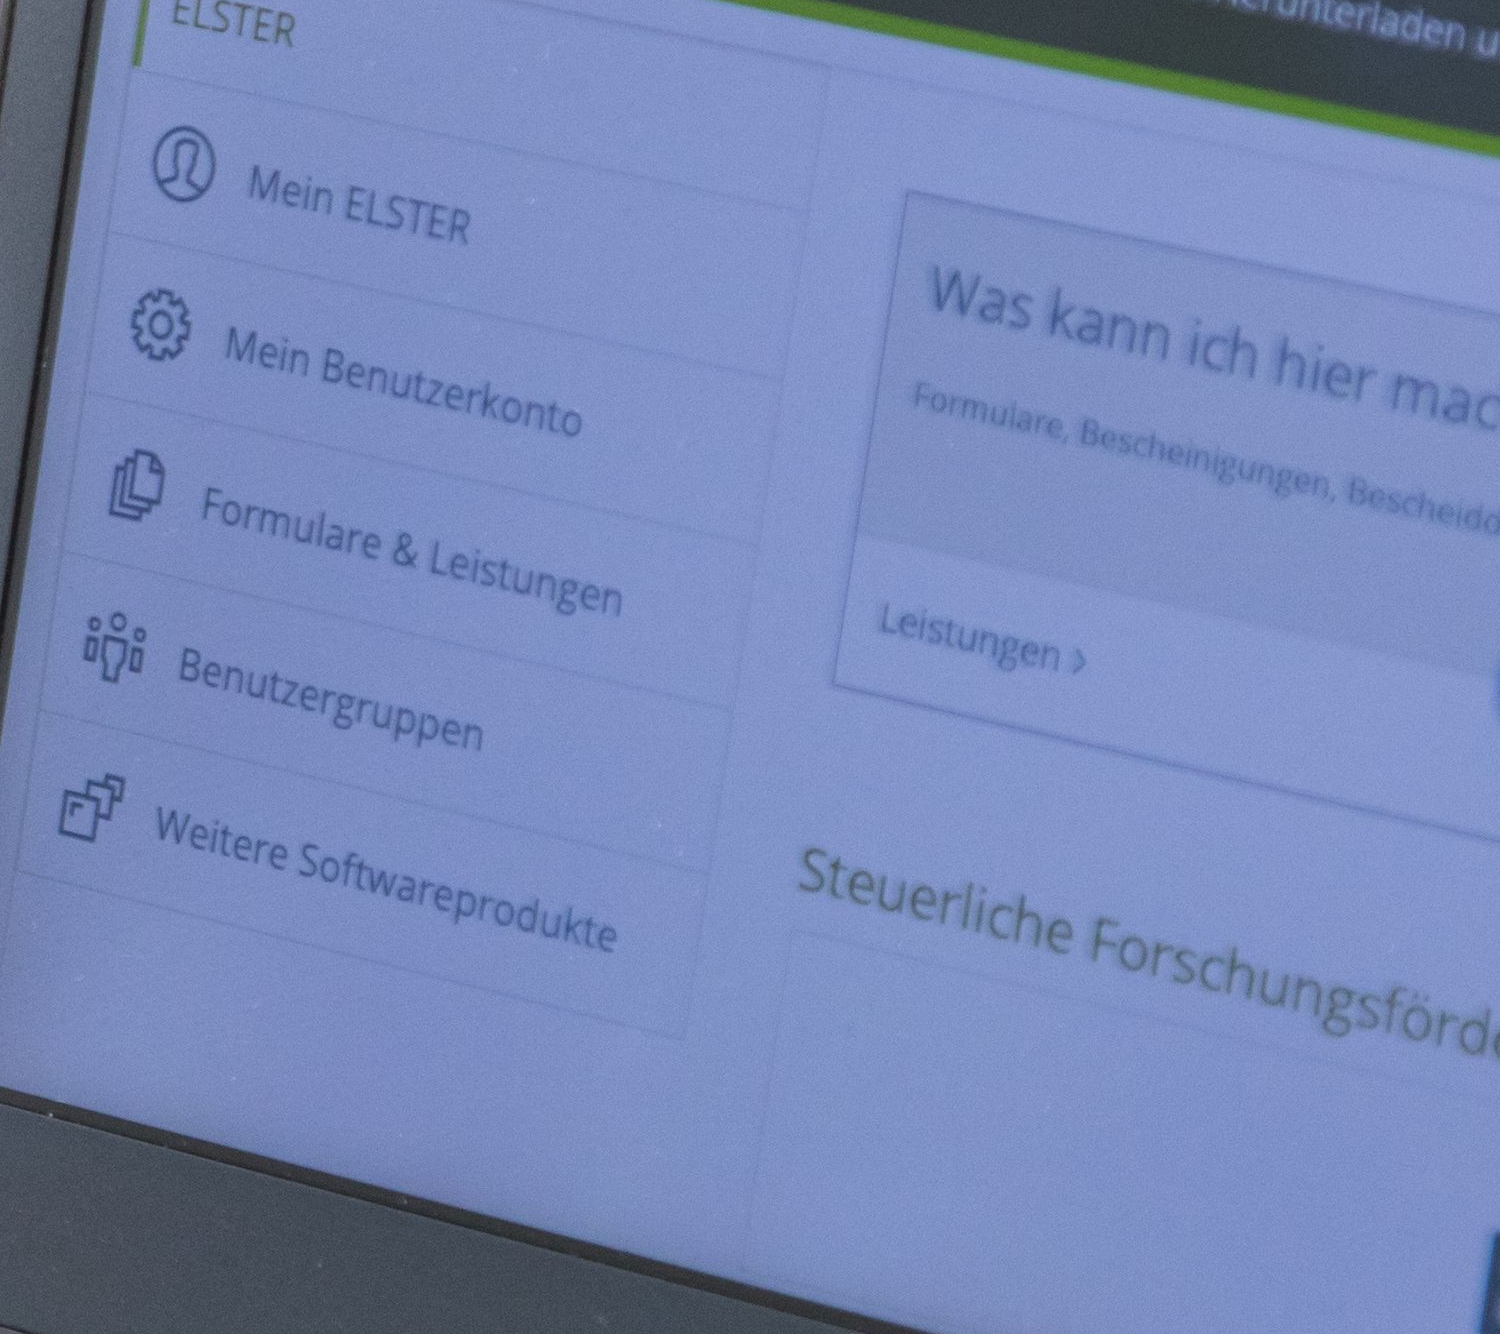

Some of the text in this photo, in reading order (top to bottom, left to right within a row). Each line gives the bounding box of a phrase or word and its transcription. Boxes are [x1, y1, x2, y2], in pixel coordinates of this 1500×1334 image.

[250, 165, 472, 245] Mein ELSTER
[225, 326, 583, 439] Mein Benutzerkonto
[928, 264, 1032, 330] Was
[1049, 287, 1170, 362] kann
[1188, 317, 1260, 379] ich
[1274, 333, 1377, 404] hier
[911, 379, 1067, 445] Formulare,
[1079, 416, 1338, 504] Bescheinigungen,
[202, 487, 624, 618] Formulare & Leistungen
[879, 602, 1061, 673] Leistungen
[178, 647, 485, 752] Benutzergruppen
[155, 804, 619, 954] Weitere Softwareprodukte
[798, 846, 1074, 955] Steuerliche
